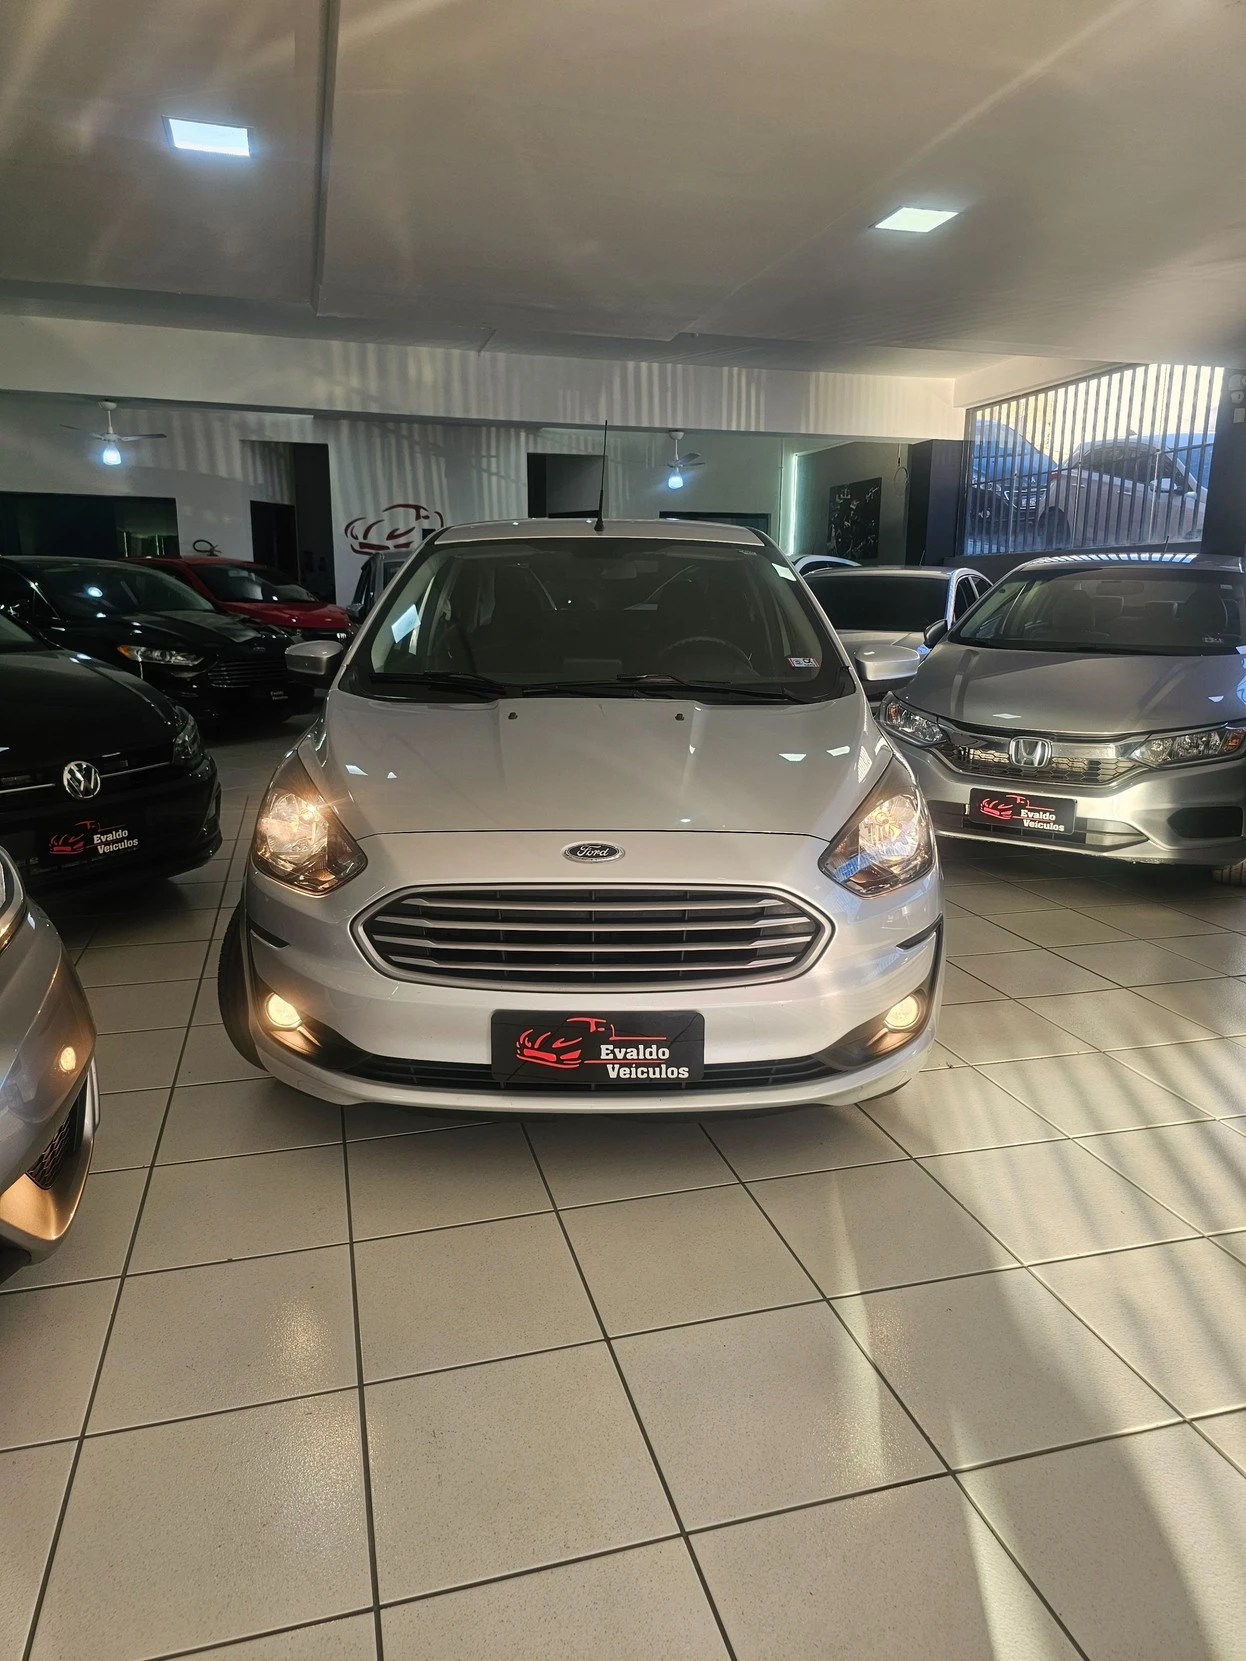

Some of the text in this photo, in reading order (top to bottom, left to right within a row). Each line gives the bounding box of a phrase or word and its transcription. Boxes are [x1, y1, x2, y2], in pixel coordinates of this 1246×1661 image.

[1020, 809, 1056, 821] Evaldo
[93, 829, 129, 844] Evaldo
[577, 845, 609, 857] Ford
[600, 1044, 670, 1060] Evaldo
